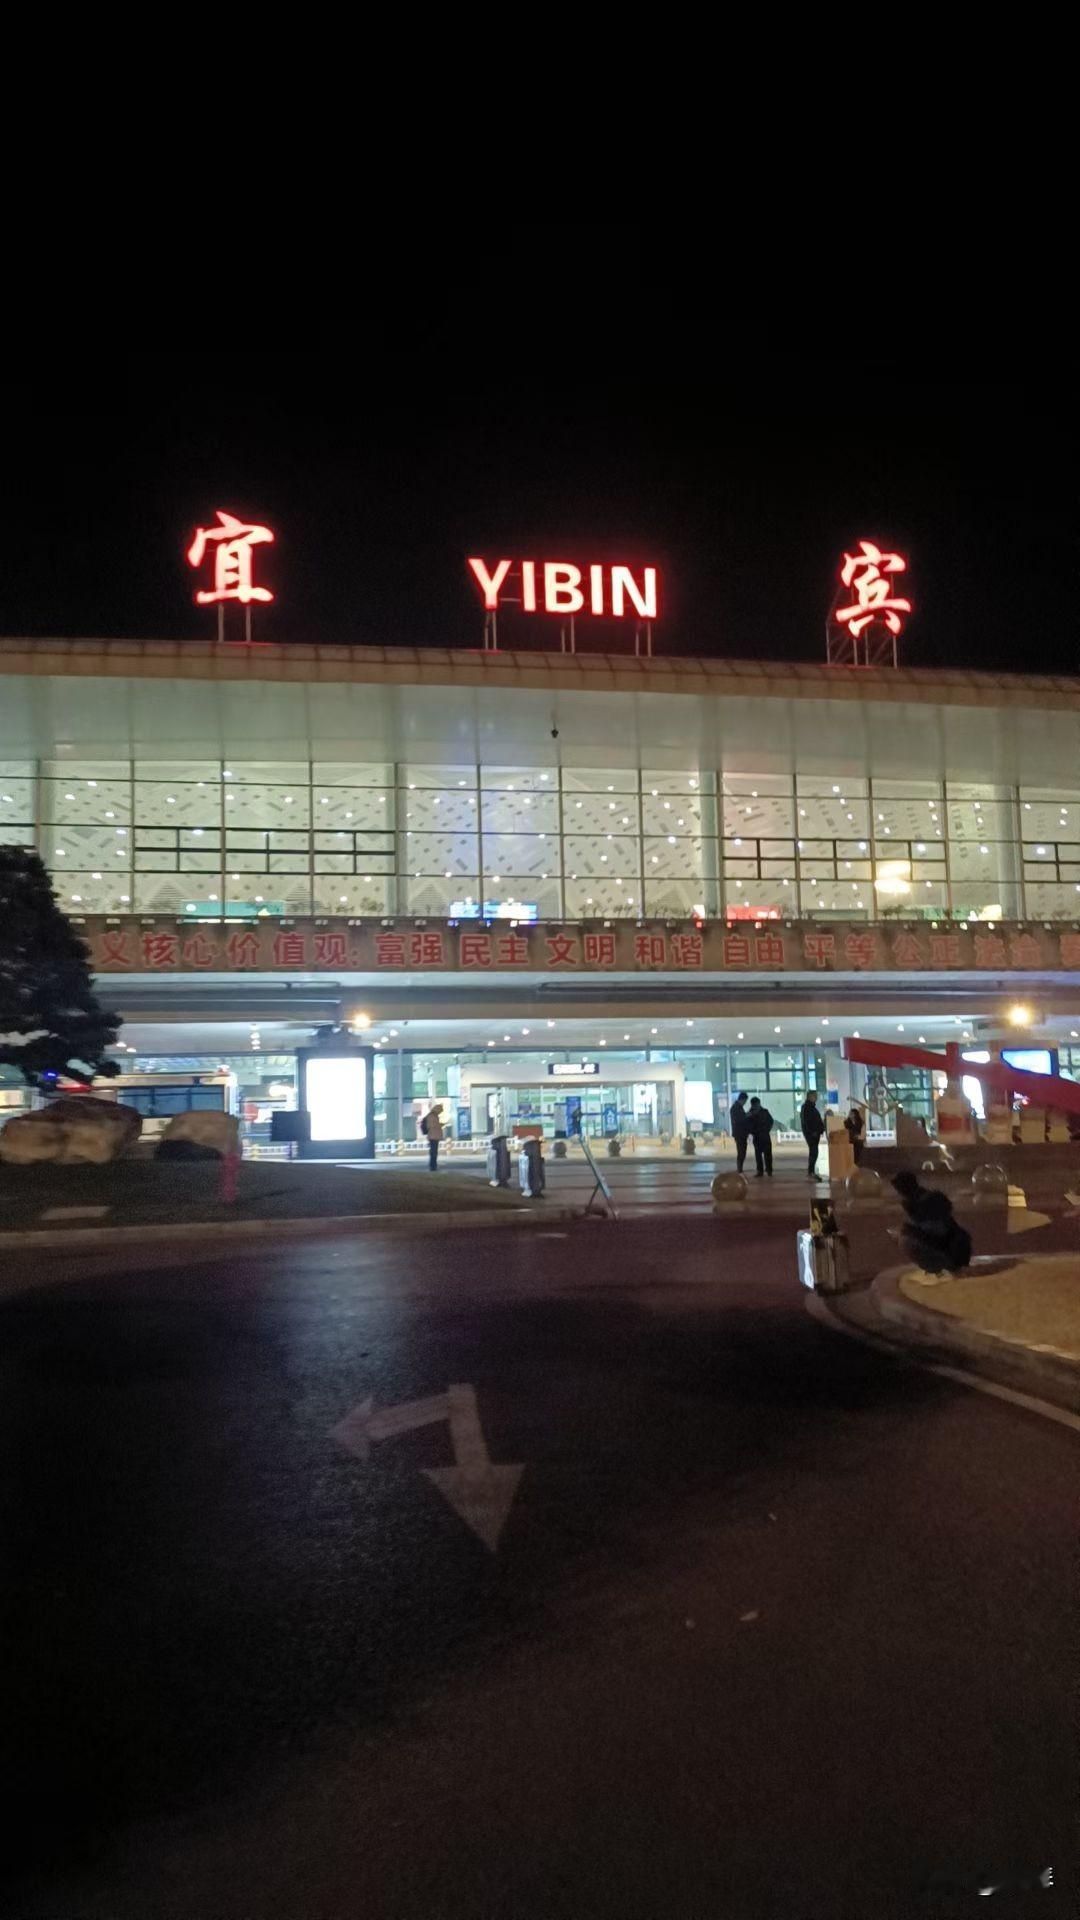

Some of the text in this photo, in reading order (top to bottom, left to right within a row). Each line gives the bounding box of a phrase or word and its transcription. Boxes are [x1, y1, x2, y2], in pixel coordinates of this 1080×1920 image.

[188, 511, 274, 604] 宜
[468, 557, 658, 618] YIBIN
[836, 541, 912, 636] 宾
[375, 932, 445, 966] 富强
[459, 932, 530, 967] 民主
[546, 933, 616, 967] 文明
[636, 933, 704, 967] 和谐
[723, 933, 785, 967] 自由
[805, 933, 879, 967] 平等
